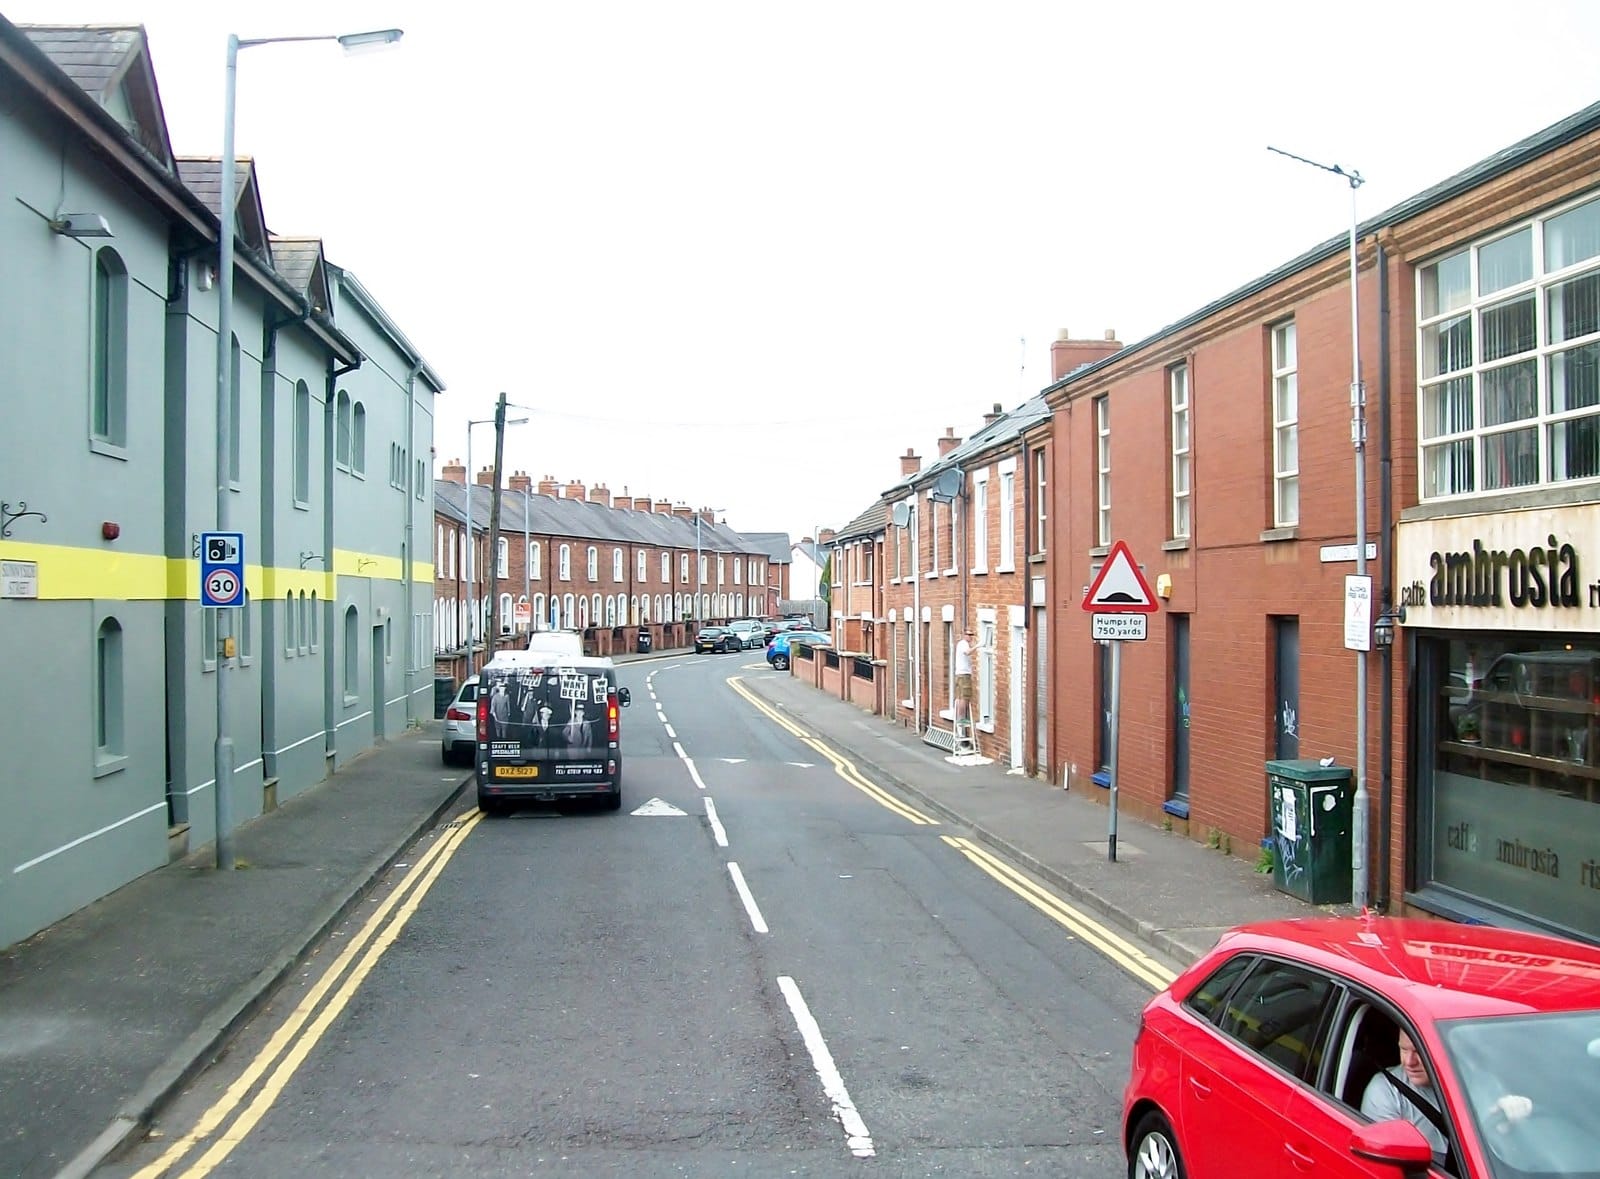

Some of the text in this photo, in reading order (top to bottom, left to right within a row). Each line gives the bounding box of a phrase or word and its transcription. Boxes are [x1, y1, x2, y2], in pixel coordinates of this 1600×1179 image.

[1430, 534, 1580, 608] ambrosia
[211, 579, 234, 592] 30
[1097, 618, 1127, 627] Humps
[1098, 627, 1141, 636] 750 yards
[563, 680, 586, 690] WANT
[562, 688, 586, 698] BEER
[500, 767, 515, 775] DXZ
